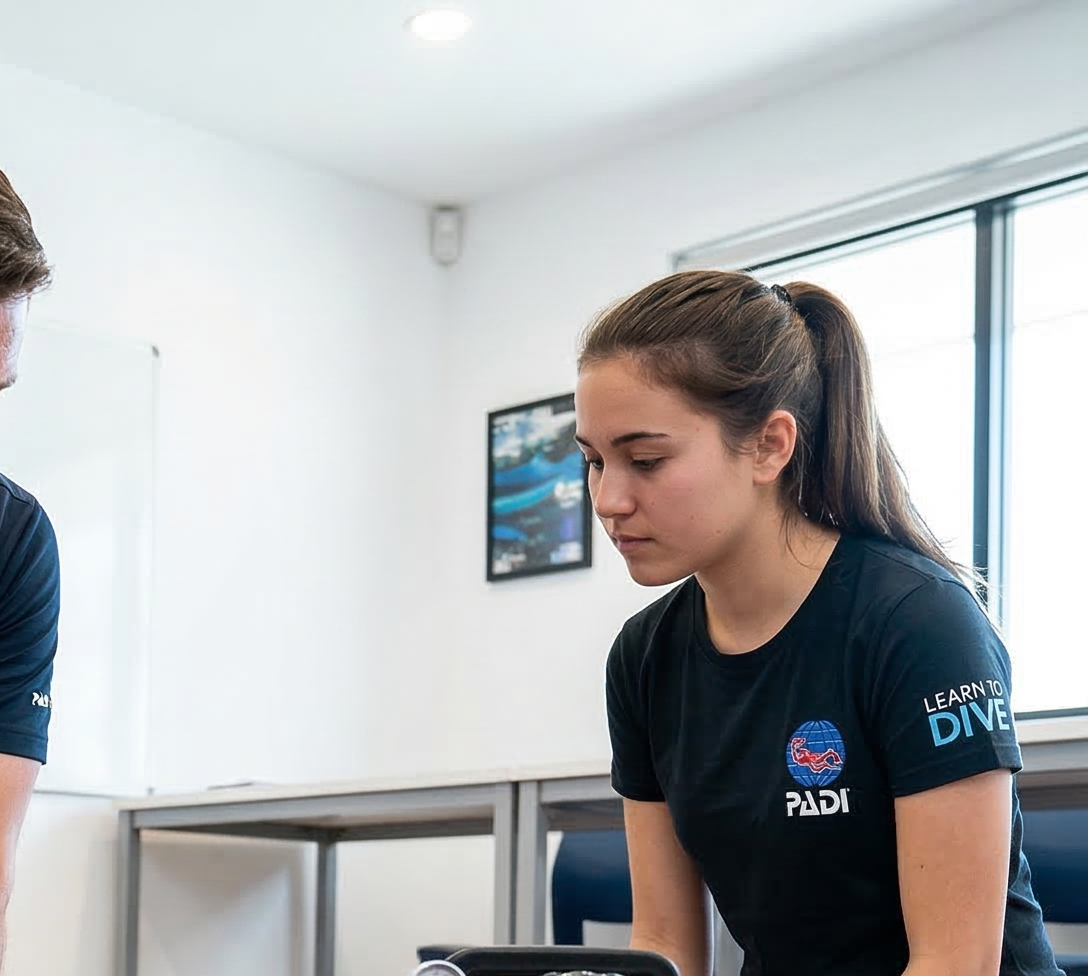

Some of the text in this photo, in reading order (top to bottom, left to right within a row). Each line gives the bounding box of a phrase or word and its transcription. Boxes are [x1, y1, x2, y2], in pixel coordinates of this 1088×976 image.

[923, 679, 1003, 713] LEARN TO
[927, 698, 1010, 747] DIVE
[786, 788, 850, 817] PADI
